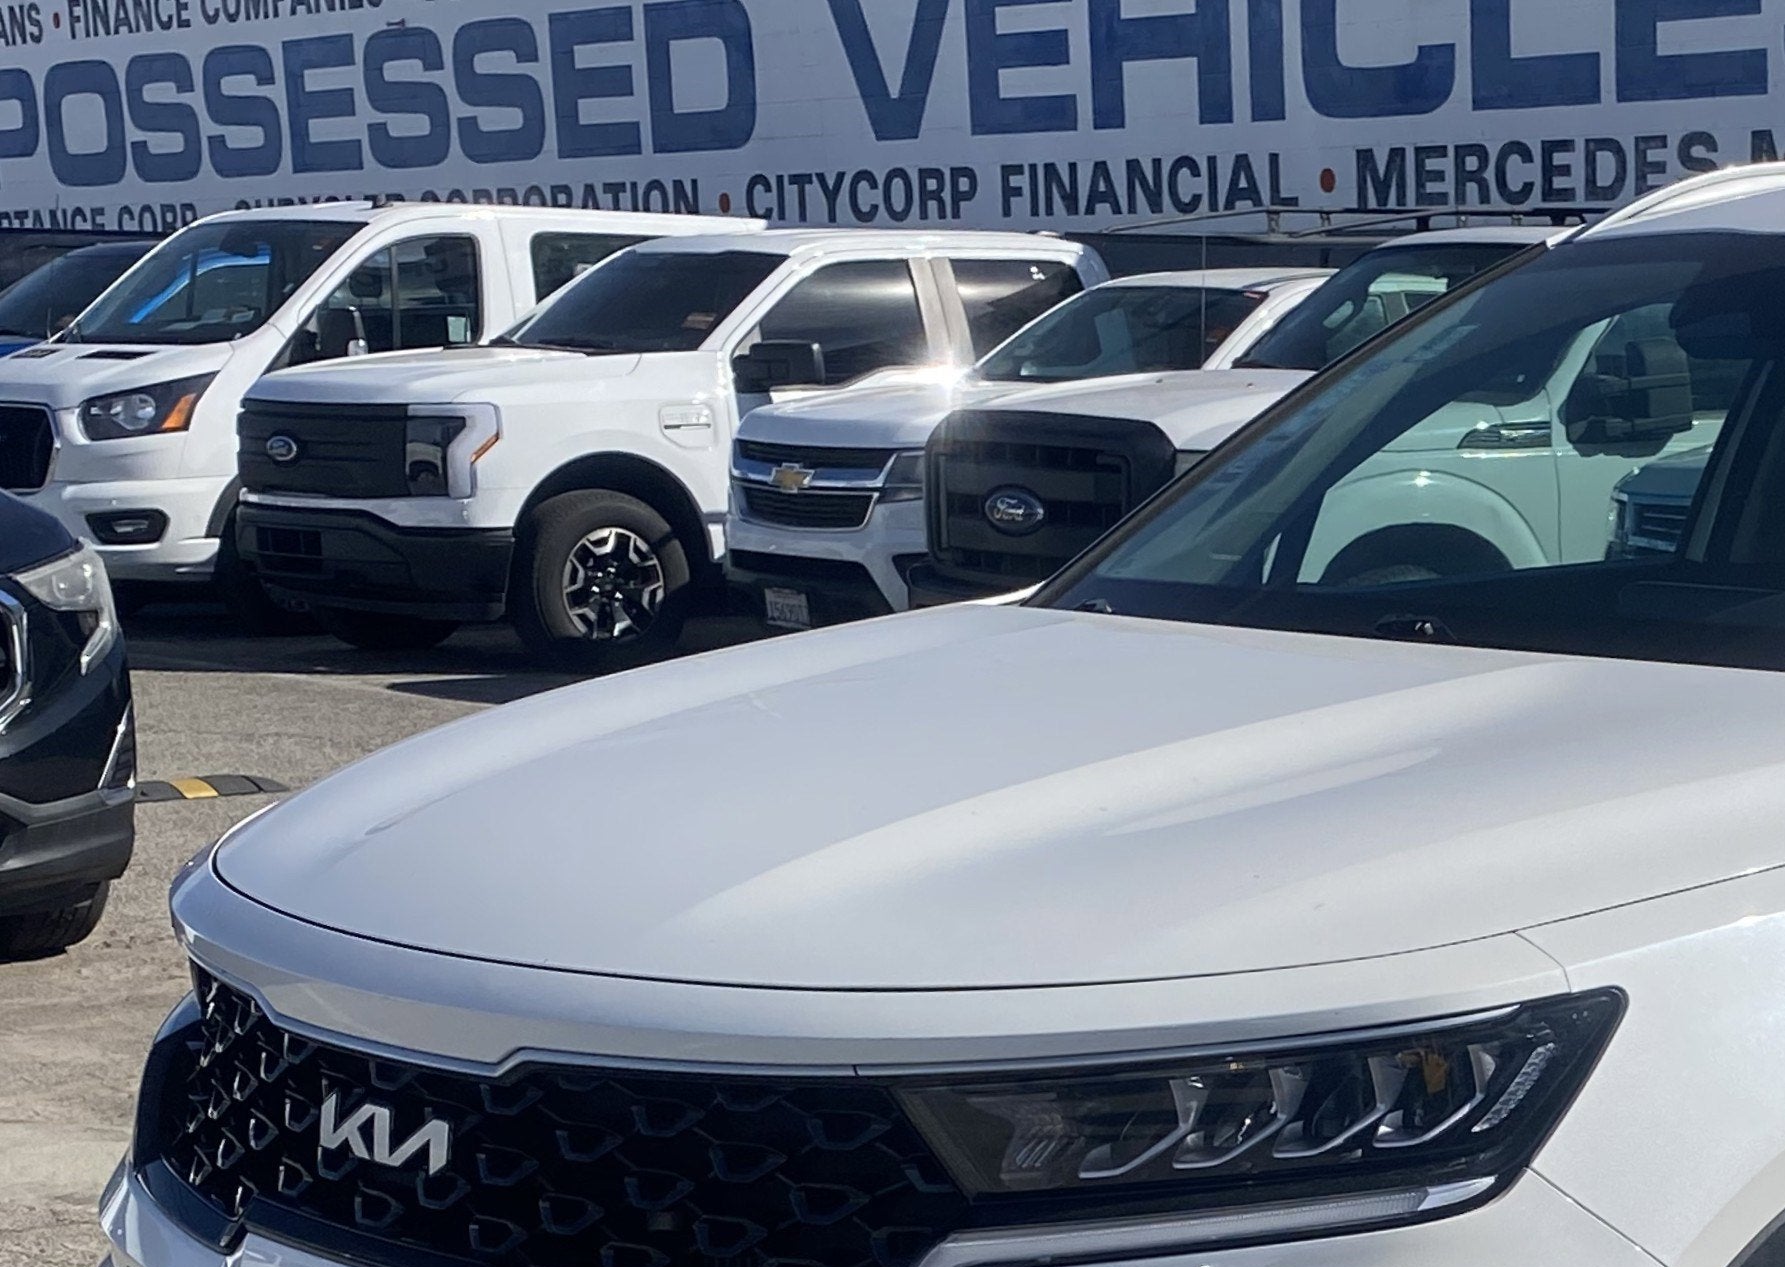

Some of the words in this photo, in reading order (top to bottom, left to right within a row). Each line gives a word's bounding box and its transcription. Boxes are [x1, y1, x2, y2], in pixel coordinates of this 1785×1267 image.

[67, 0, 193, 40] FINANCE
[745, 165, 980, 224] CITYCORP
[1000, 152, 1299, 217] FINANCIAL
[1354, 130, 1719, 211] MERCEDES
[319, 1091, 453, 1177] KIA
